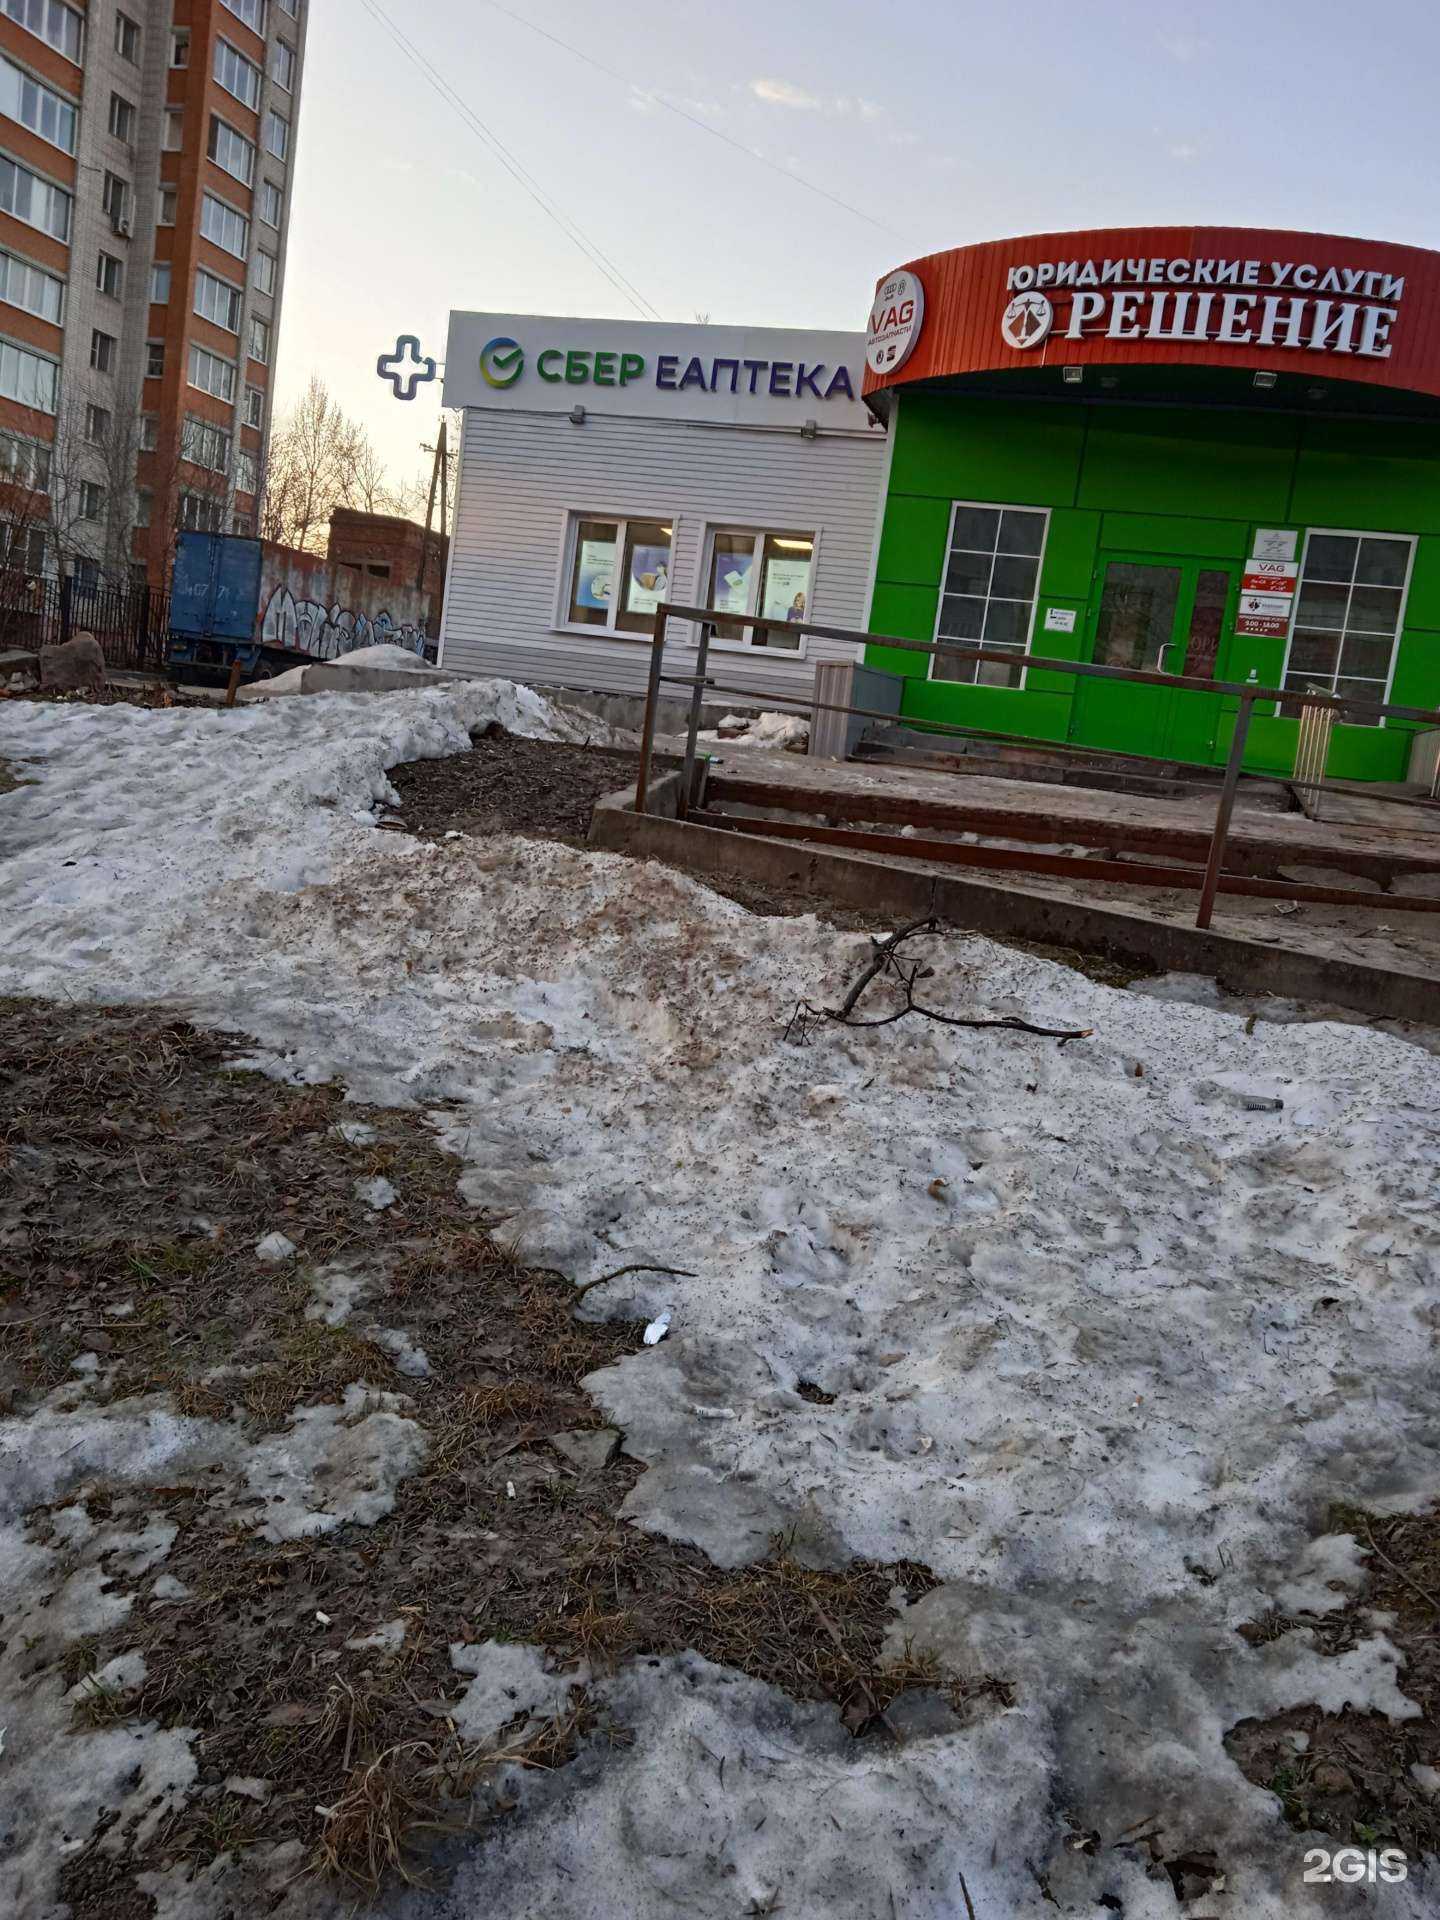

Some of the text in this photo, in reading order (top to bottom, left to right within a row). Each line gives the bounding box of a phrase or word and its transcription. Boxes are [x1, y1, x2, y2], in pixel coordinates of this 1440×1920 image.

[1007, 259, 1405, 301] ЮРИДИЧЕСКИЕ УСЛУГИ
[871, 300, 914, 334] VAG
[1065, 291, 1398, 358] РЕШЕНИЕ
[536, 349, 854, 400] СБЕР ЕАПТЕКА
[1259, 563, 1285, 573] VAG
